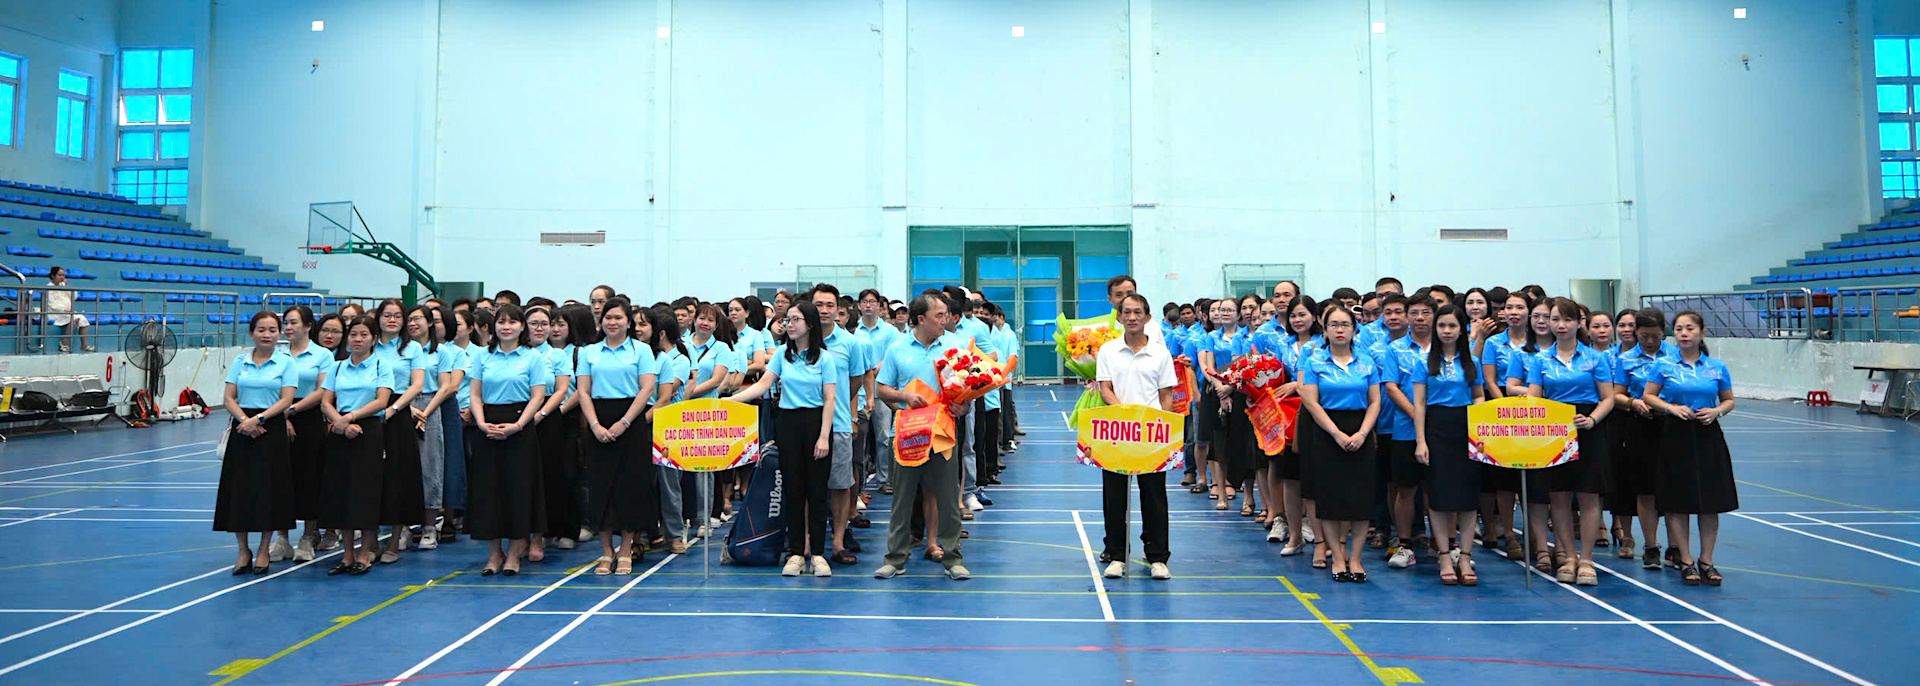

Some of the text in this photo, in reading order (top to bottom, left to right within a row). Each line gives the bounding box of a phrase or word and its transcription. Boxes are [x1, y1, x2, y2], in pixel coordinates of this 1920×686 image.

[106, 356, 113, 382] 6
[682, 410, 728, 423] BAN QLDA ĐTXD
[1497, 407, 1546, 419] BAN QLDA ĐTXD
[665, 425, 746, 441] CÁC CÔNG TRÌNH DÂN DỤNG
[1091, 417, 1170, 445] TRỌNG TÀI
[1477, 422, 1568, 437] CÁC CÔNG TRÌNH GIAO THÔNG
[681, 442, 730, 458] VÀ CÔNG NGHIỆP
[768, 469, 783, 518] Wilson
